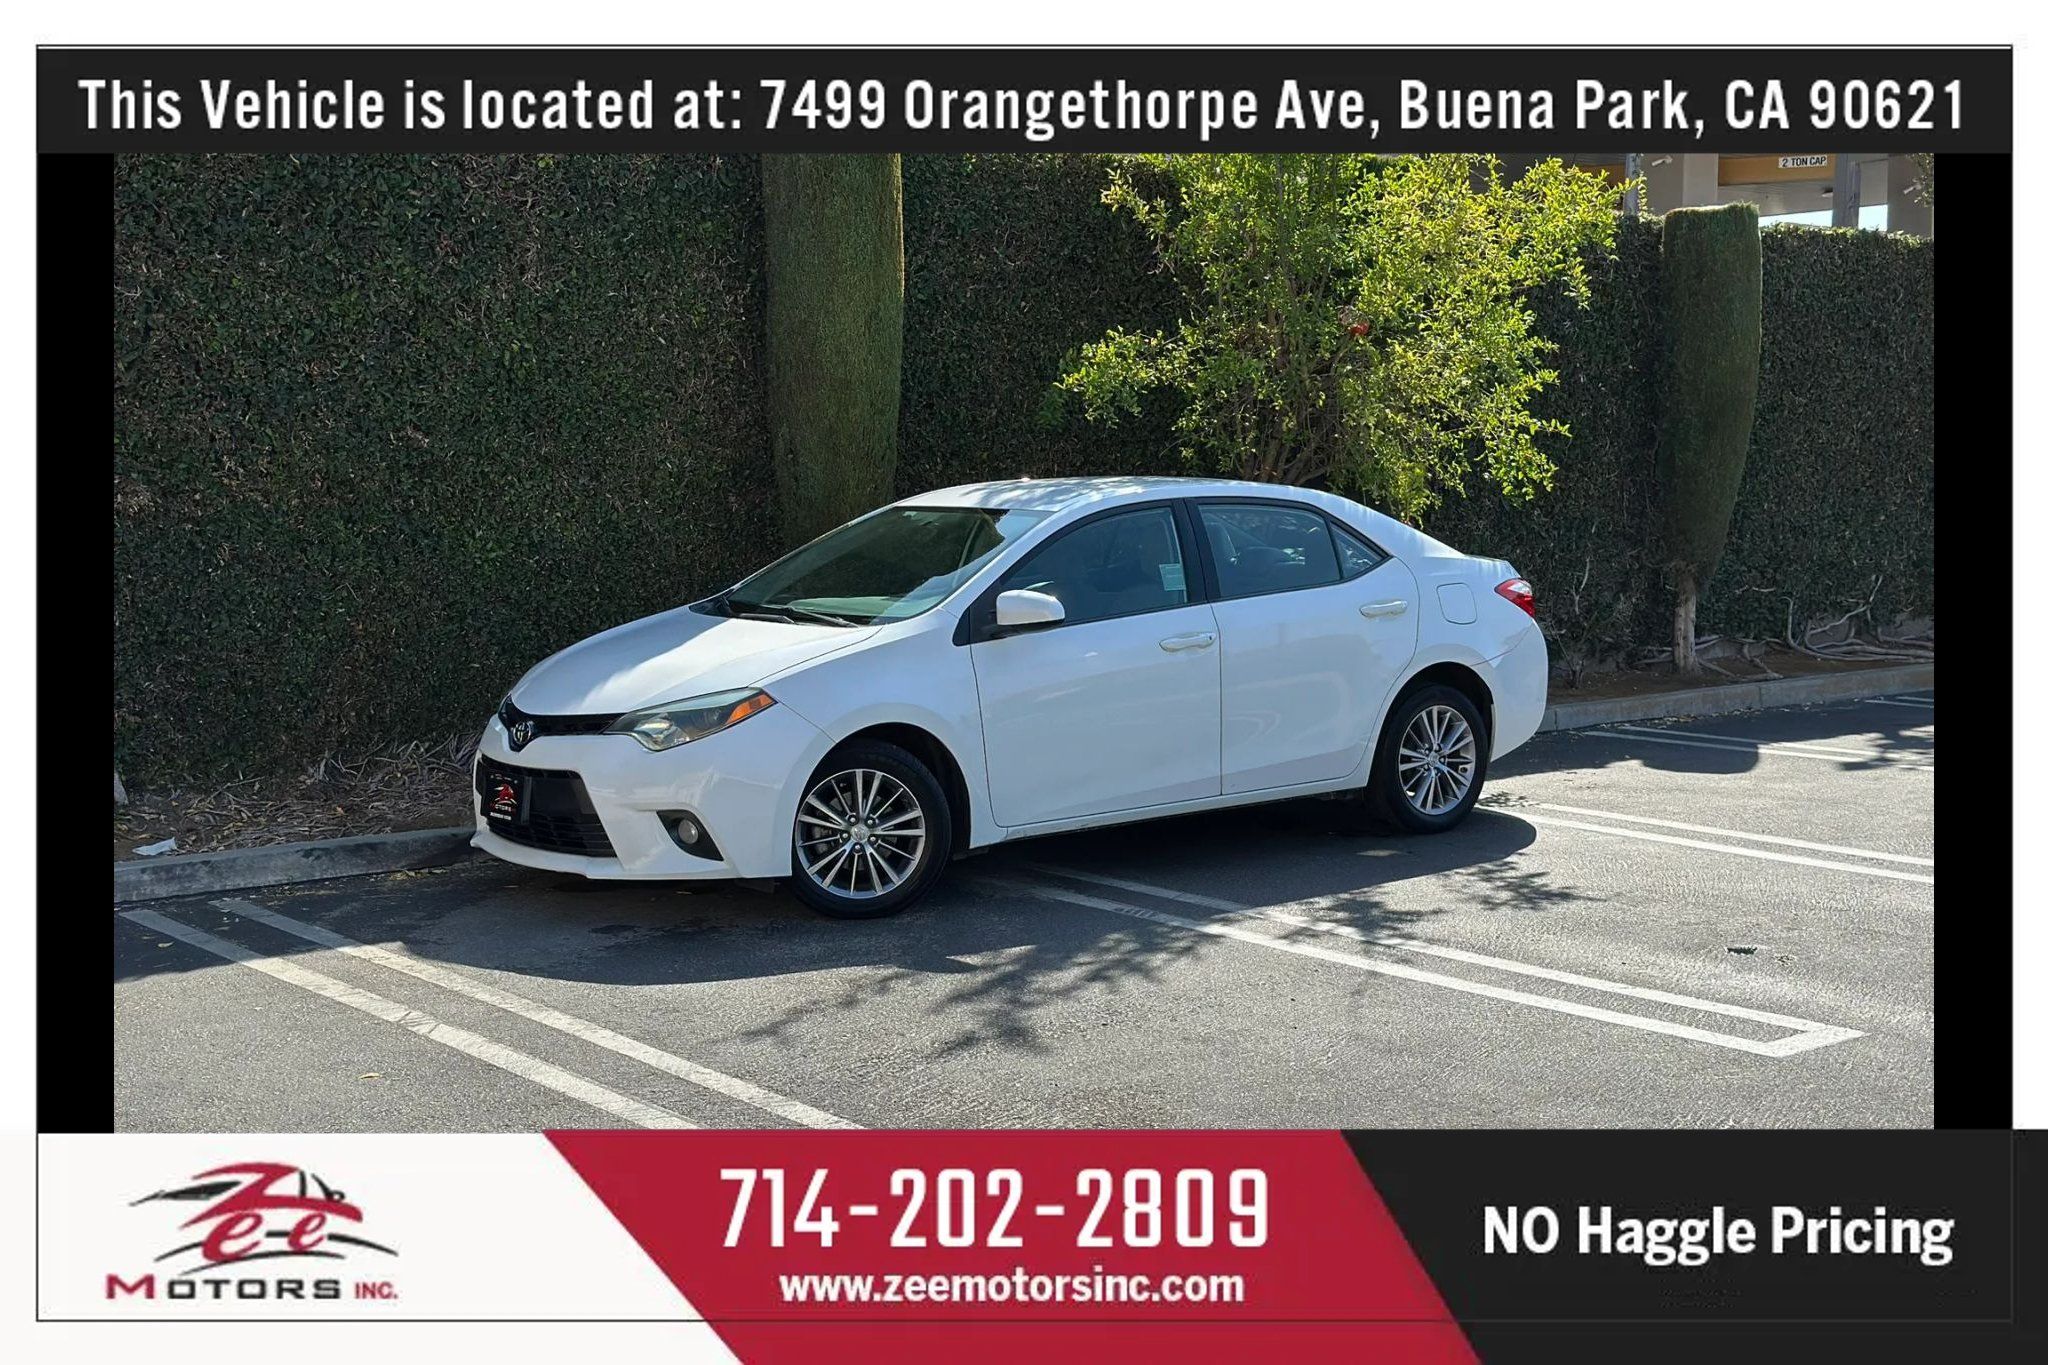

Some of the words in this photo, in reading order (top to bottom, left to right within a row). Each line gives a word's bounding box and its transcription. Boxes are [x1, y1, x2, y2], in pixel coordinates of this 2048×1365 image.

[1782, 158, 1788, 167] 2
[1791, 157, 1808, 167] TON
[1809, 156, 1827, 166] CAP
